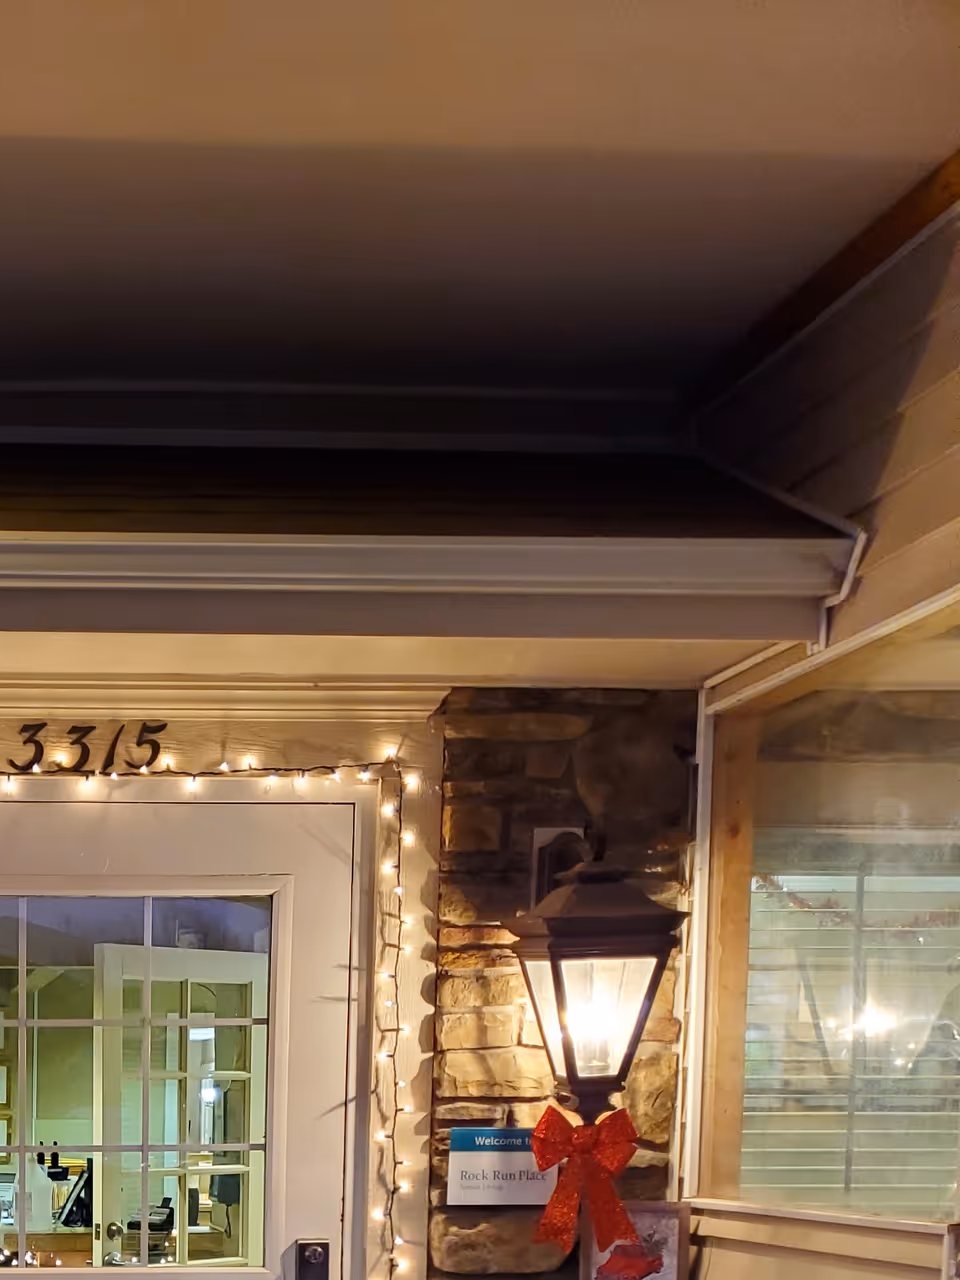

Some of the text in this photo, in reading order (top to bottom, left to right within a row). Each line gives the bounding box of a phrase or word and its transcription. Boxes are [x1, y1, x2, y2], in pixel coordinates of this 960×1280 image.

[6, 721, 168, 772] 3315
[474, 1136, 523, 1146] Welcome
[459, 1169, 548, 1182] Rock Run Place
